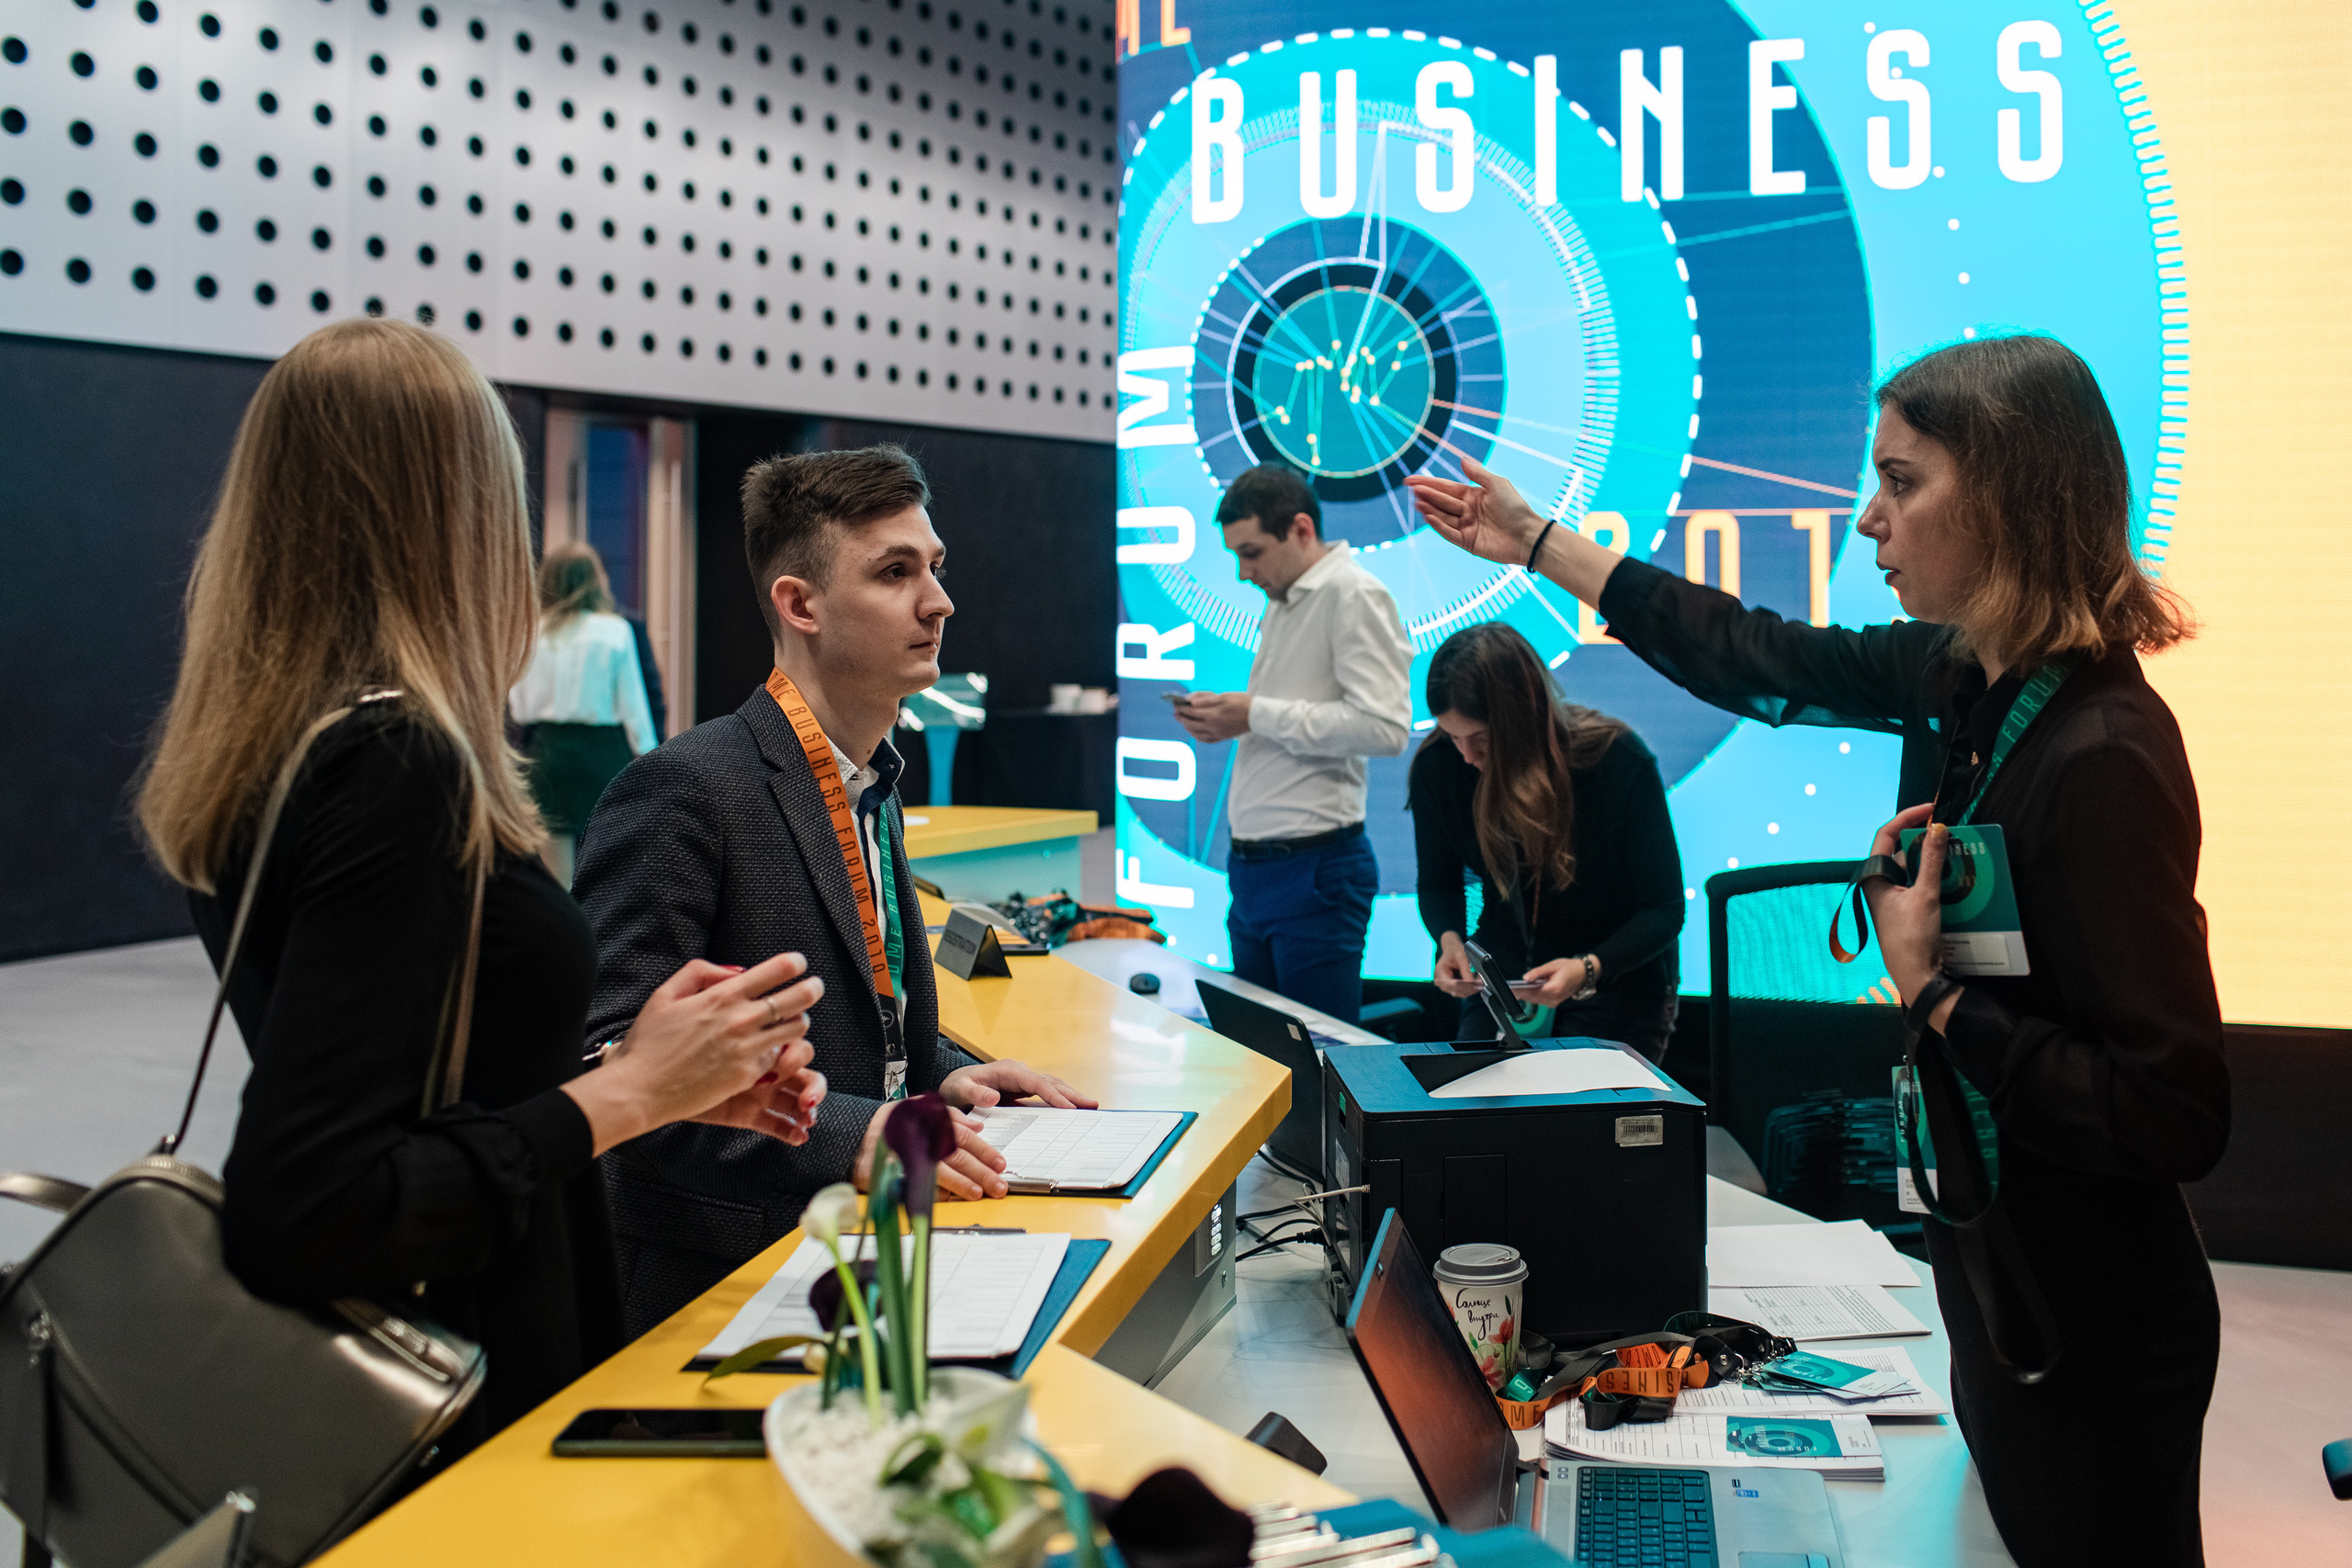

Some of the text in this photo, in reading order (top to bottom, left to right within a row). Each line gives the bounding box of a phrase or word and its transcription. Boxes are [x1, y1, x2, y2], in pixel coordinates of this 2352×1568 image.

[1192, 20, 2063, 224] BUSINESS
[1116, 346, 1197, 908] FORUM
[1578, 509, 1831, 645] 201
[787, 705, 846, 817] BUSINESS
[837, 826, 869, 904] FORUM
